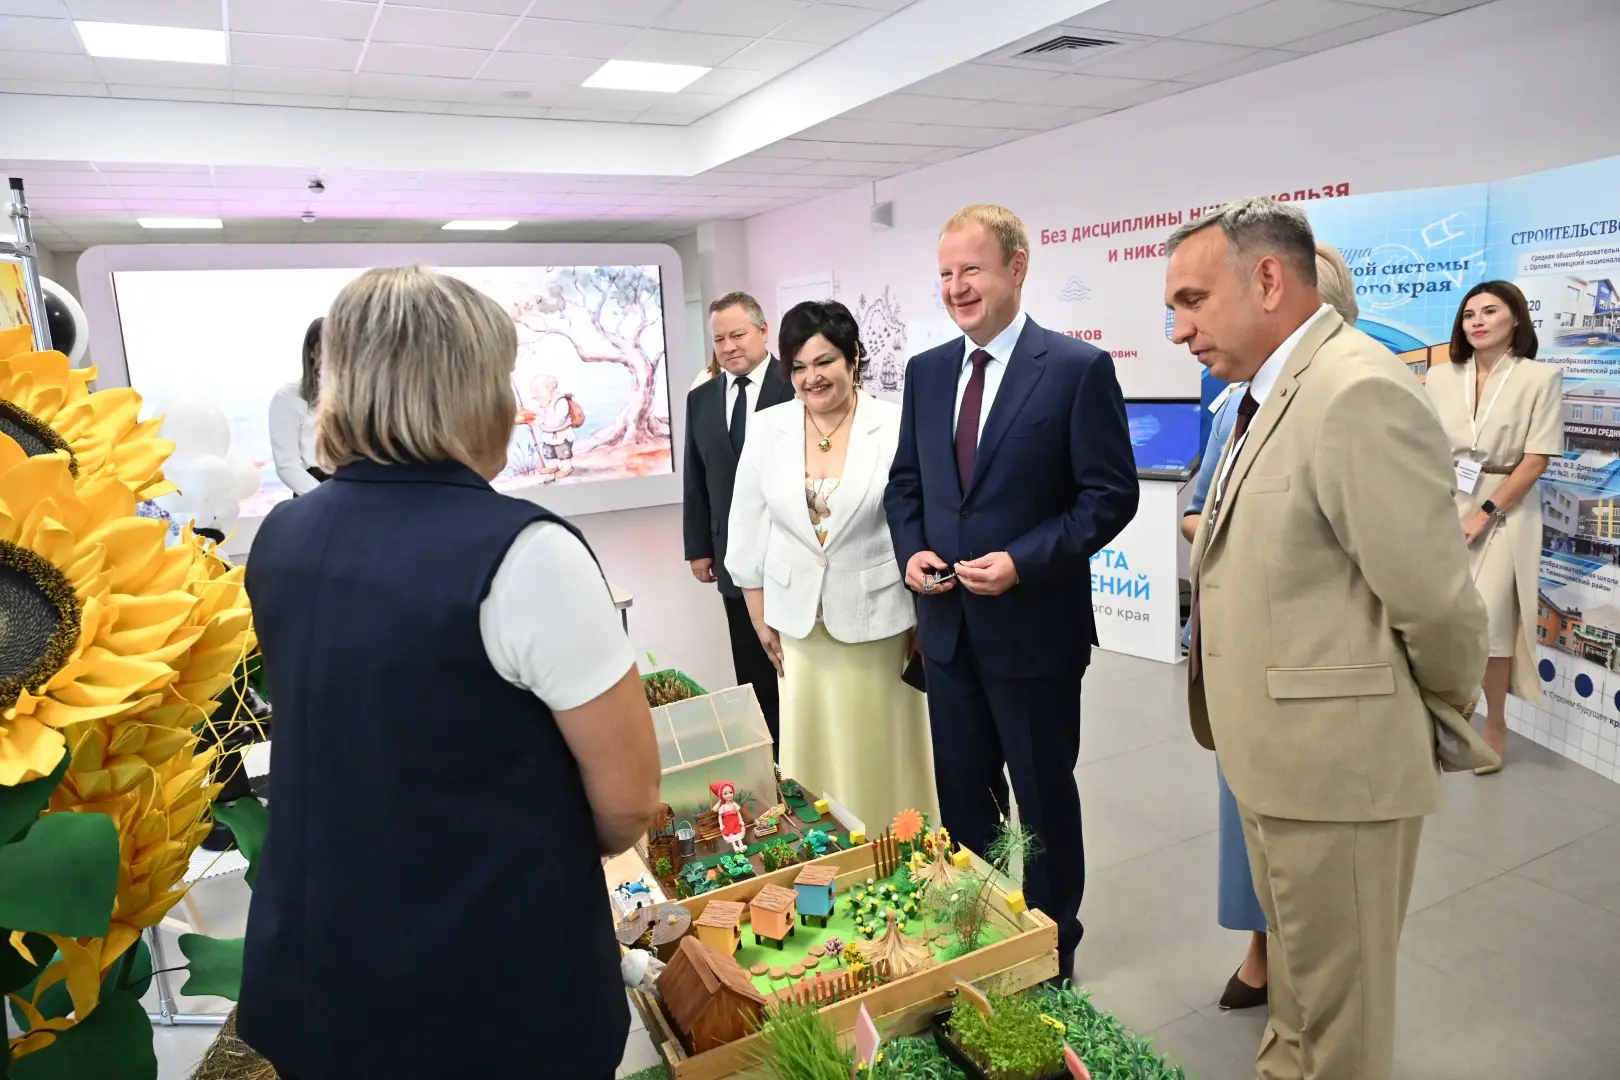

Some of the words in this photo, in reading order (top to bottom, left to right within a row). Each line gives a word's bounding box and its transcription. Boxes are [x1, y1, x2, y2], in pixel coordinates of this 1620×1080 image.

[1041, 229, 1067, 245] Без
[1072, 210, 1183, 243] дисциплины
[1511, 219, 1620, 246] СТРОИТЕЛЬСТВ
[1108, 249, 1118, 263] и
[1124, 242, 1168, 261] ника
[1531, 254, 1555, 262] Средняя
[1556, 247, 1620, 259] общеобразовательн
[1382, 260, 1470, 275] системы
[1553, 258, 1585, 268] Немецкий
[1586, 256, 1620, 266] националь
[1356, 284, 1392, 296] ого
[1397, 280, 1452, 298] края
[1529, 300, 1541, 311] 20
[1062, 329, 1102, 340] аков
[1109, 350, 1138, 358] ович
[1547, 357, 1617, 366] общеобразовательная
[1566, 366, 1608, 374] Тальменский
[1598, 429, 1620, 438] СРЕДНЯ
[1597, 575, 1619, 585] школа
[1091, 573, 1150, 601] ЕНИЙ
[1591, 582, 1611, 592] район
[1092, 604, 1113, 616] ого
[1117, 608, 1150, 622] края
[1549, 691, 1575, 708] Строим
